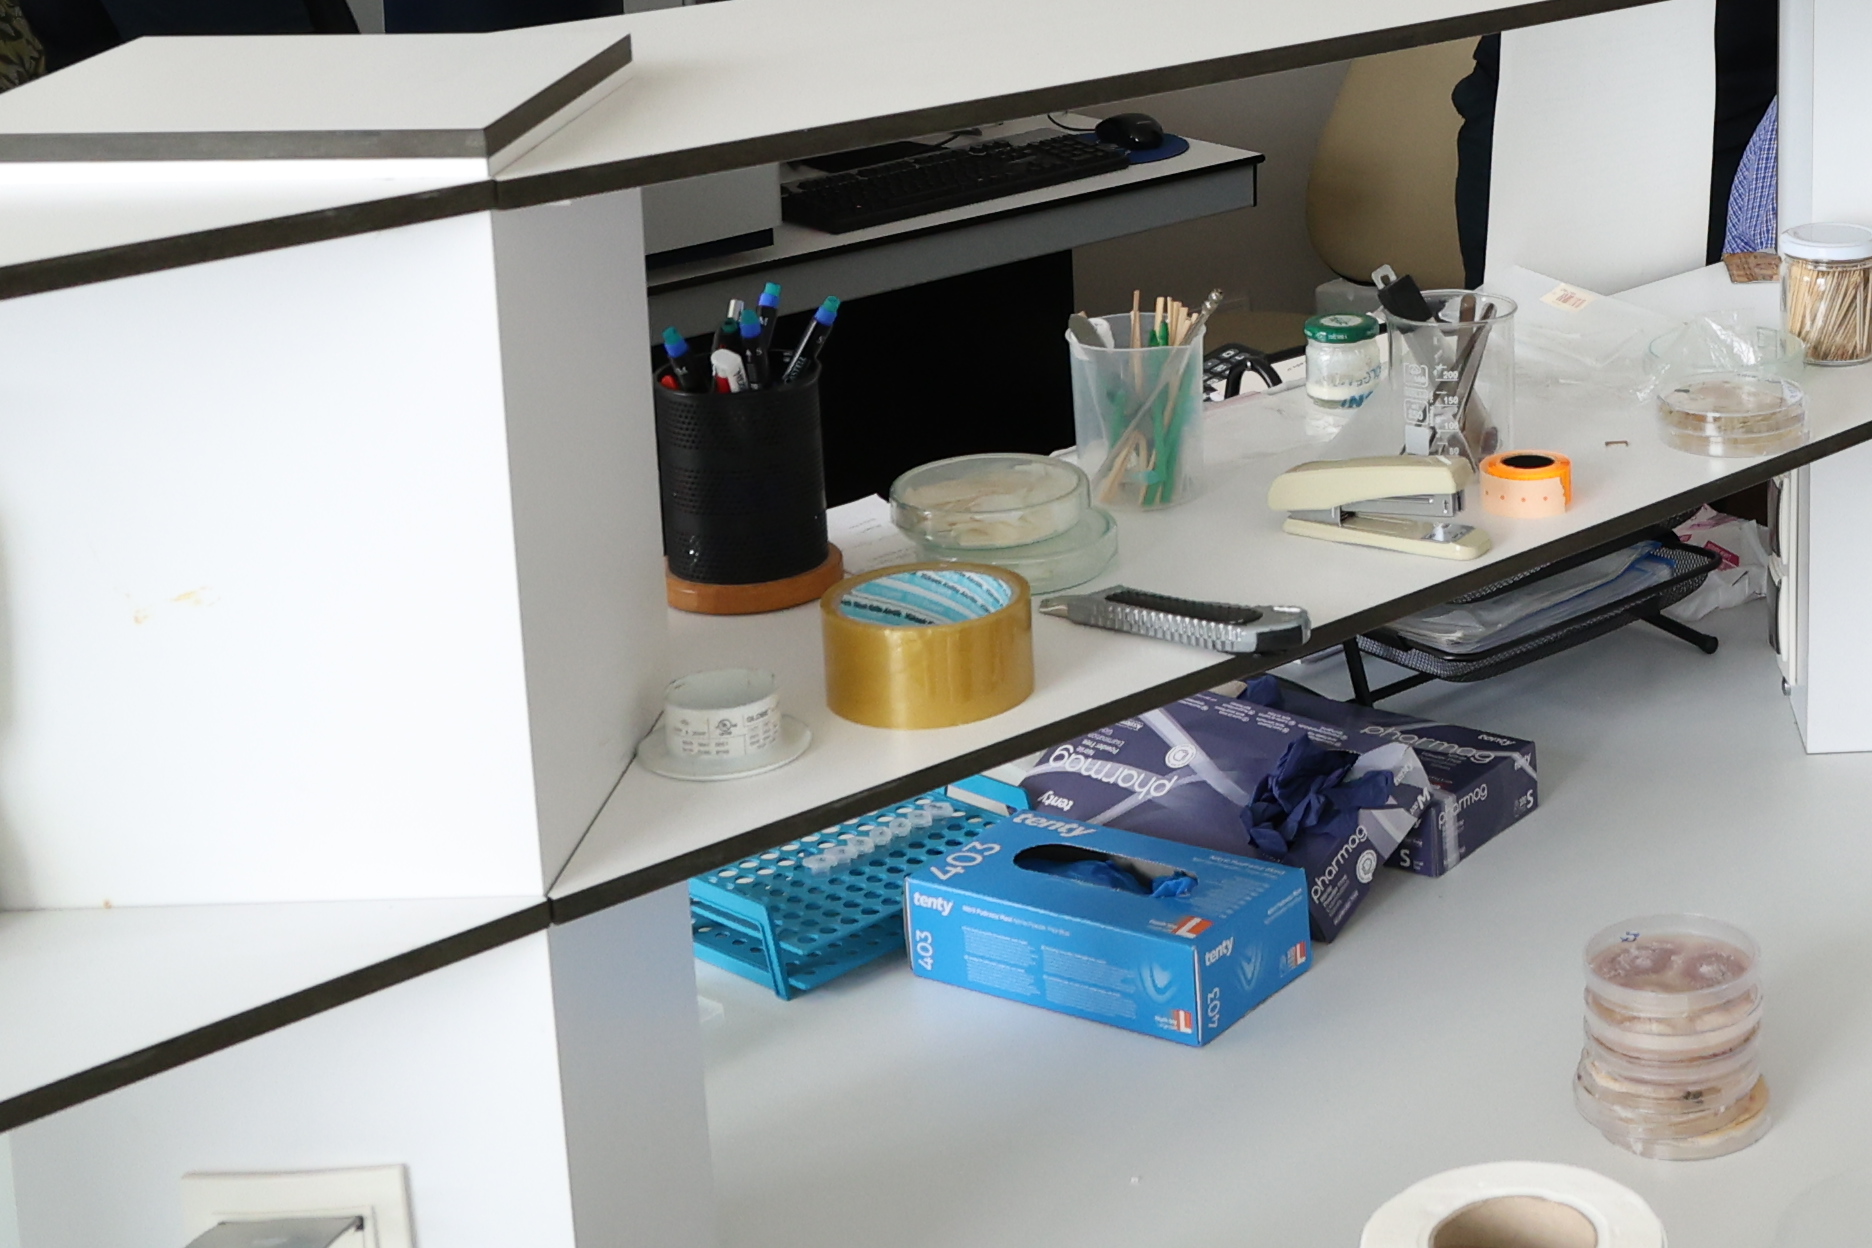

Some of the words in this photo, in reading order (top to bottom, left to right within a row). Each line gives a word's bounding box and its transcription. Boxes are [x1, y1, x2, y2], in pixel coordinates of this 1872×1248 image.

[1442, 370, 1459, 380] 200
[1443, 396, 1459, 405] 150
[1359, 725, 1494, 765] pharmag
[1049, 744, 1178, 800] pharmag
[1037, 790, 1075, 812] tenty
[1416, 786, 1431, 810] M
[1526, 789, 1534, 809] S
[1012, 813, 1097, 838] tenty
[930, 841, 1001, 881] 403
[1311, 824, 1369, 905] pharmag
[1400, 849, 1411, 868] S
[913, 891, 954, 917] tenty
[1176, 917, 1202, 939] L
[916, 929, 934, 971] 403
[1205, 936, 1234, 967] tenty
[1296, 942, 1306, 965] L
[1208, 987, 1220, 1029] 403
[1179, 1009, 1193, 1034] L
